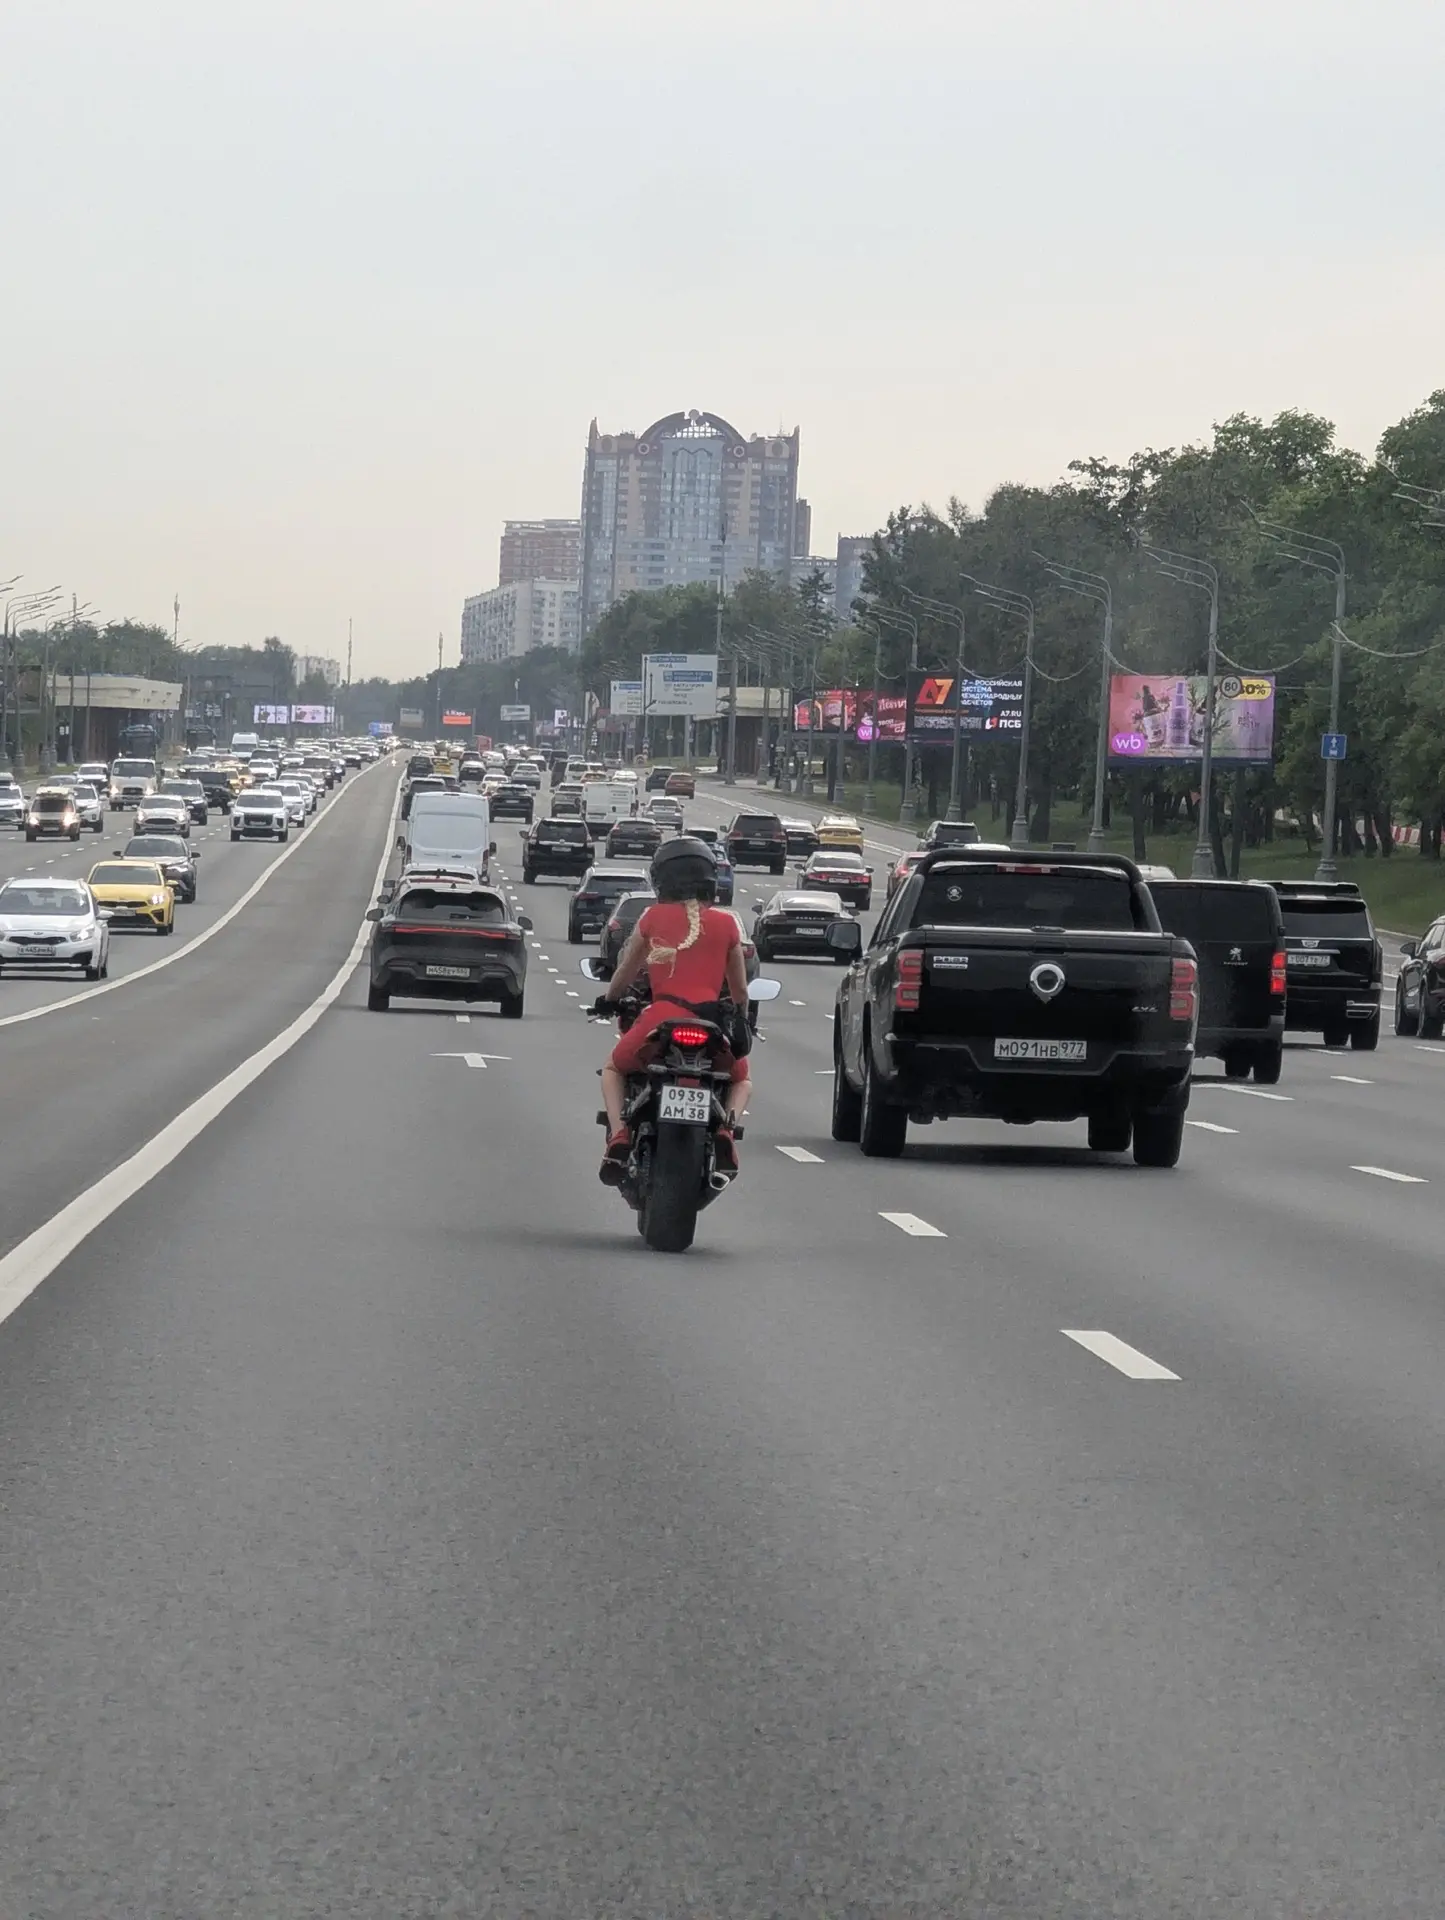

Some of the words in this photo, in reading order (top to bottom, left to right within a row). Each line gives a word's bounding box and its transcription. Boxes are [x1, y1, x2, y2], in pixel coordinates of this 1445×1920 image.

[975, 679, 1022, 687] РОССИЙСКАЯ
[1225, 682, 1238, 691] 80
[999, 719, 1022, 729] ПСБ
[1115, 734, 1141, 749] wb
[669, 1089, 705, 1102] 0939
[663, 1106, 684, 1117] АМ
[689, 1108, 705, 1119] 38
